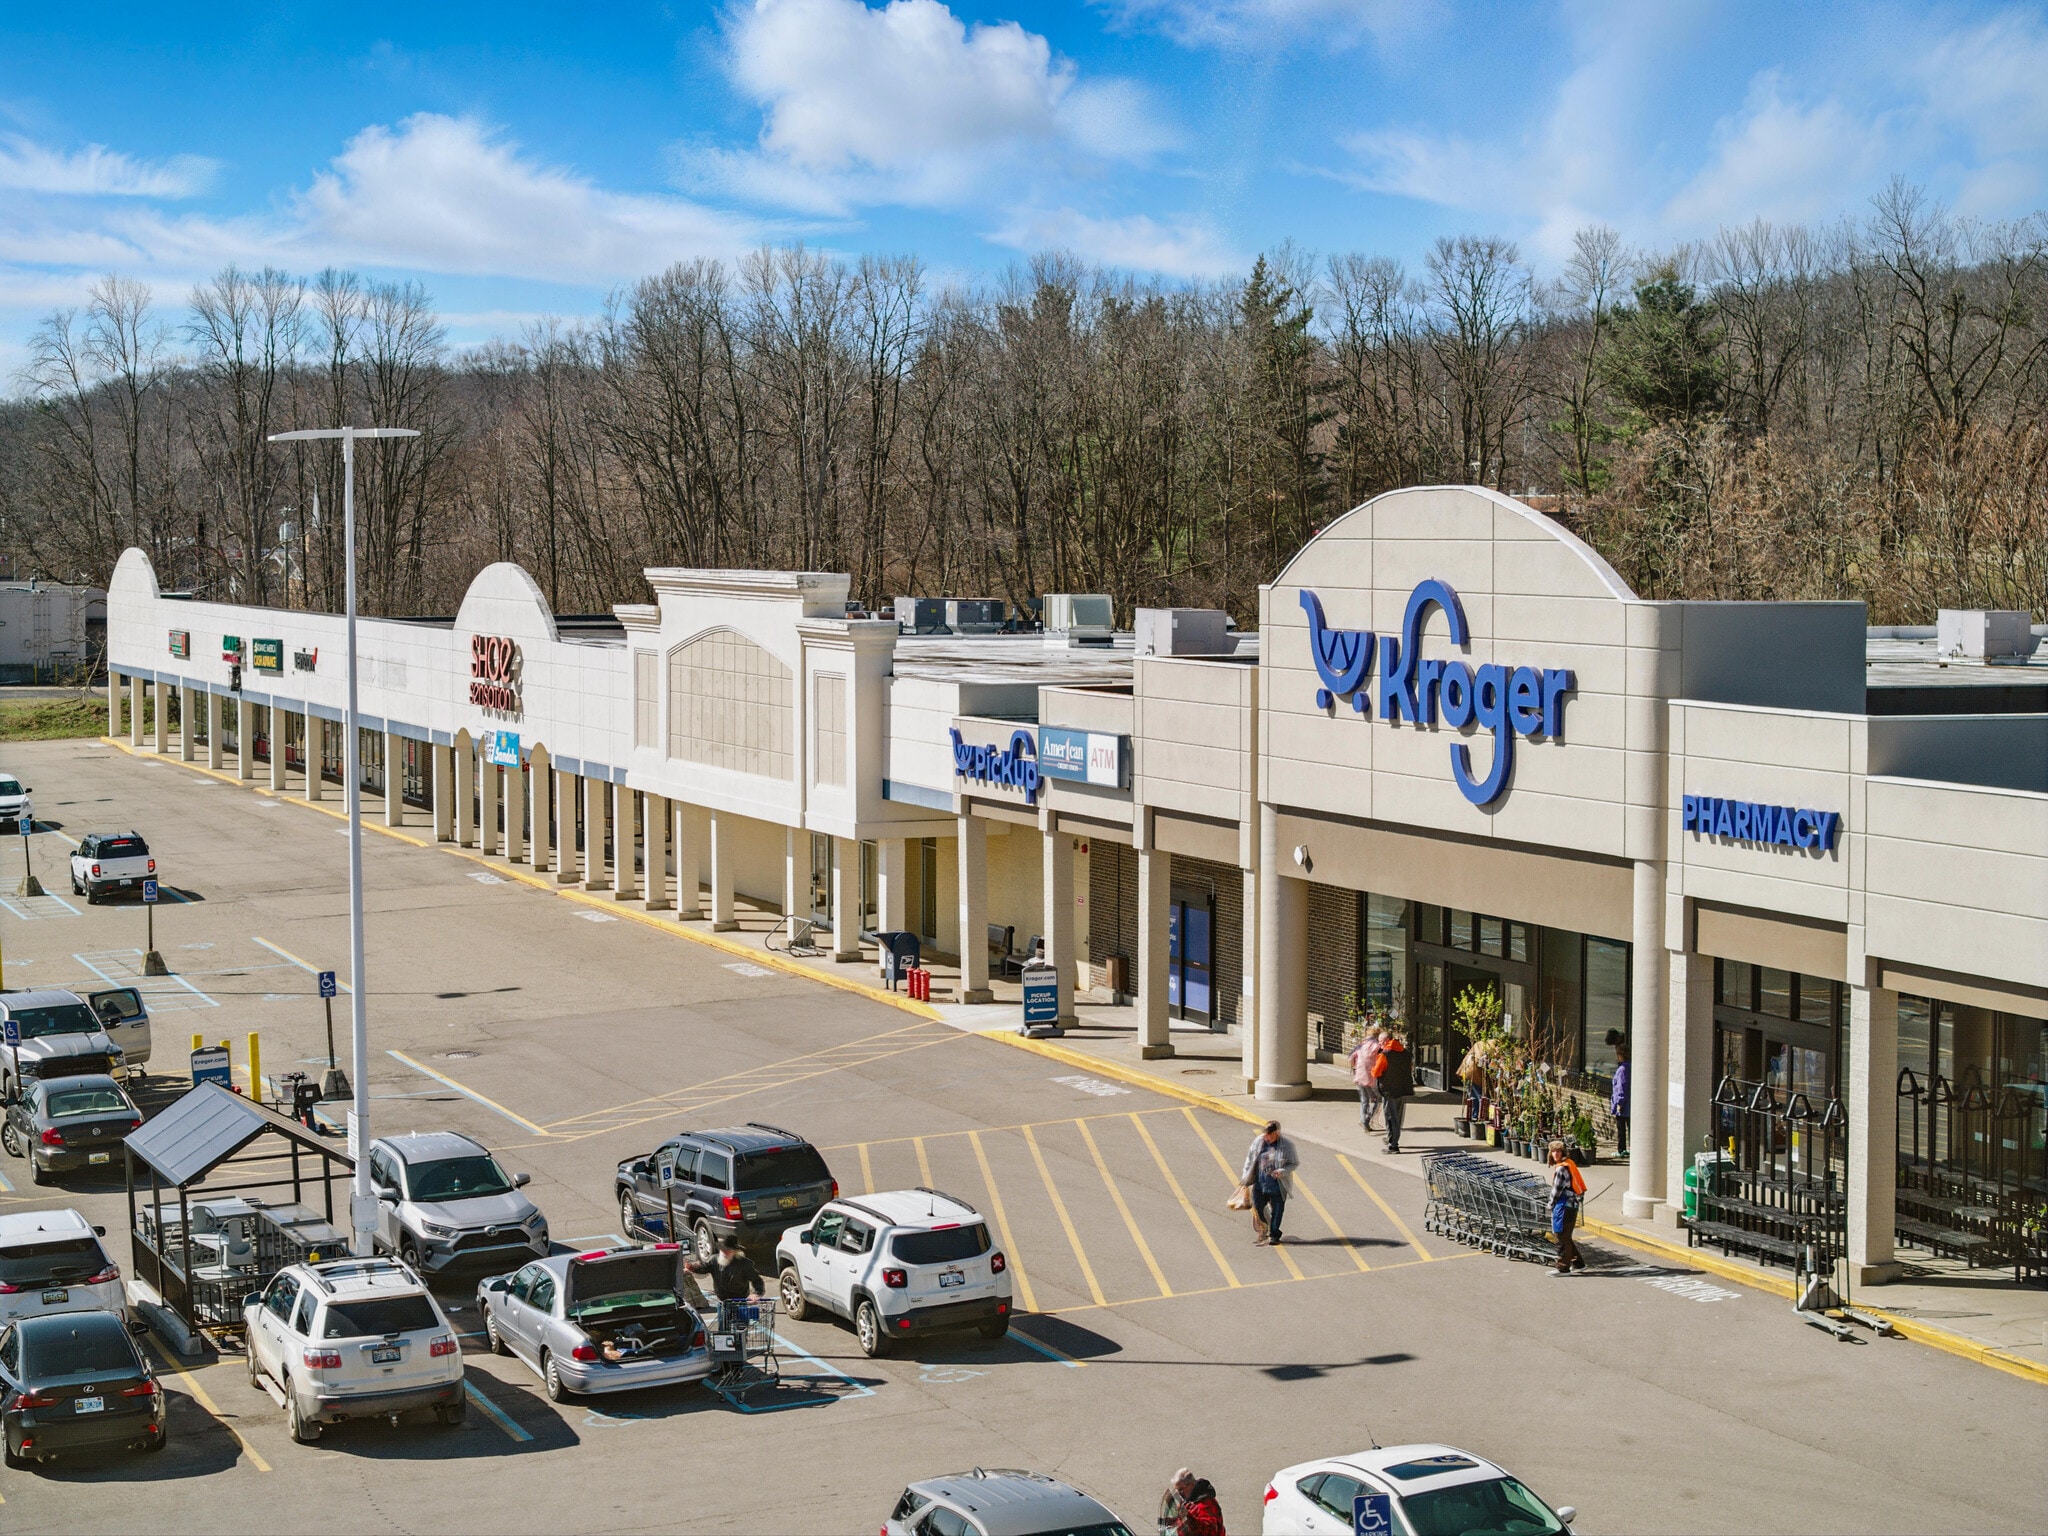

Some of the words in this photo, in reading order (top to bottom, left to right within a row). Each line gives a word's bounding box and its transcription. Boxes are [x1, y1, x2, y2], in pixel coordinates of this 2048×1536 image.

[471, 634, 516, 684] SHOE
[469, 682, 515, 711] sensation
[1379, 579, 1576, 805] Kroger
[975, 730, 1044, 804] Pickup
[1091, 747, 1115, 770] ATM
[1683, 795, 1839, 850] PHARMACY
[194, 1057, 227, 1065] Kroger.com
